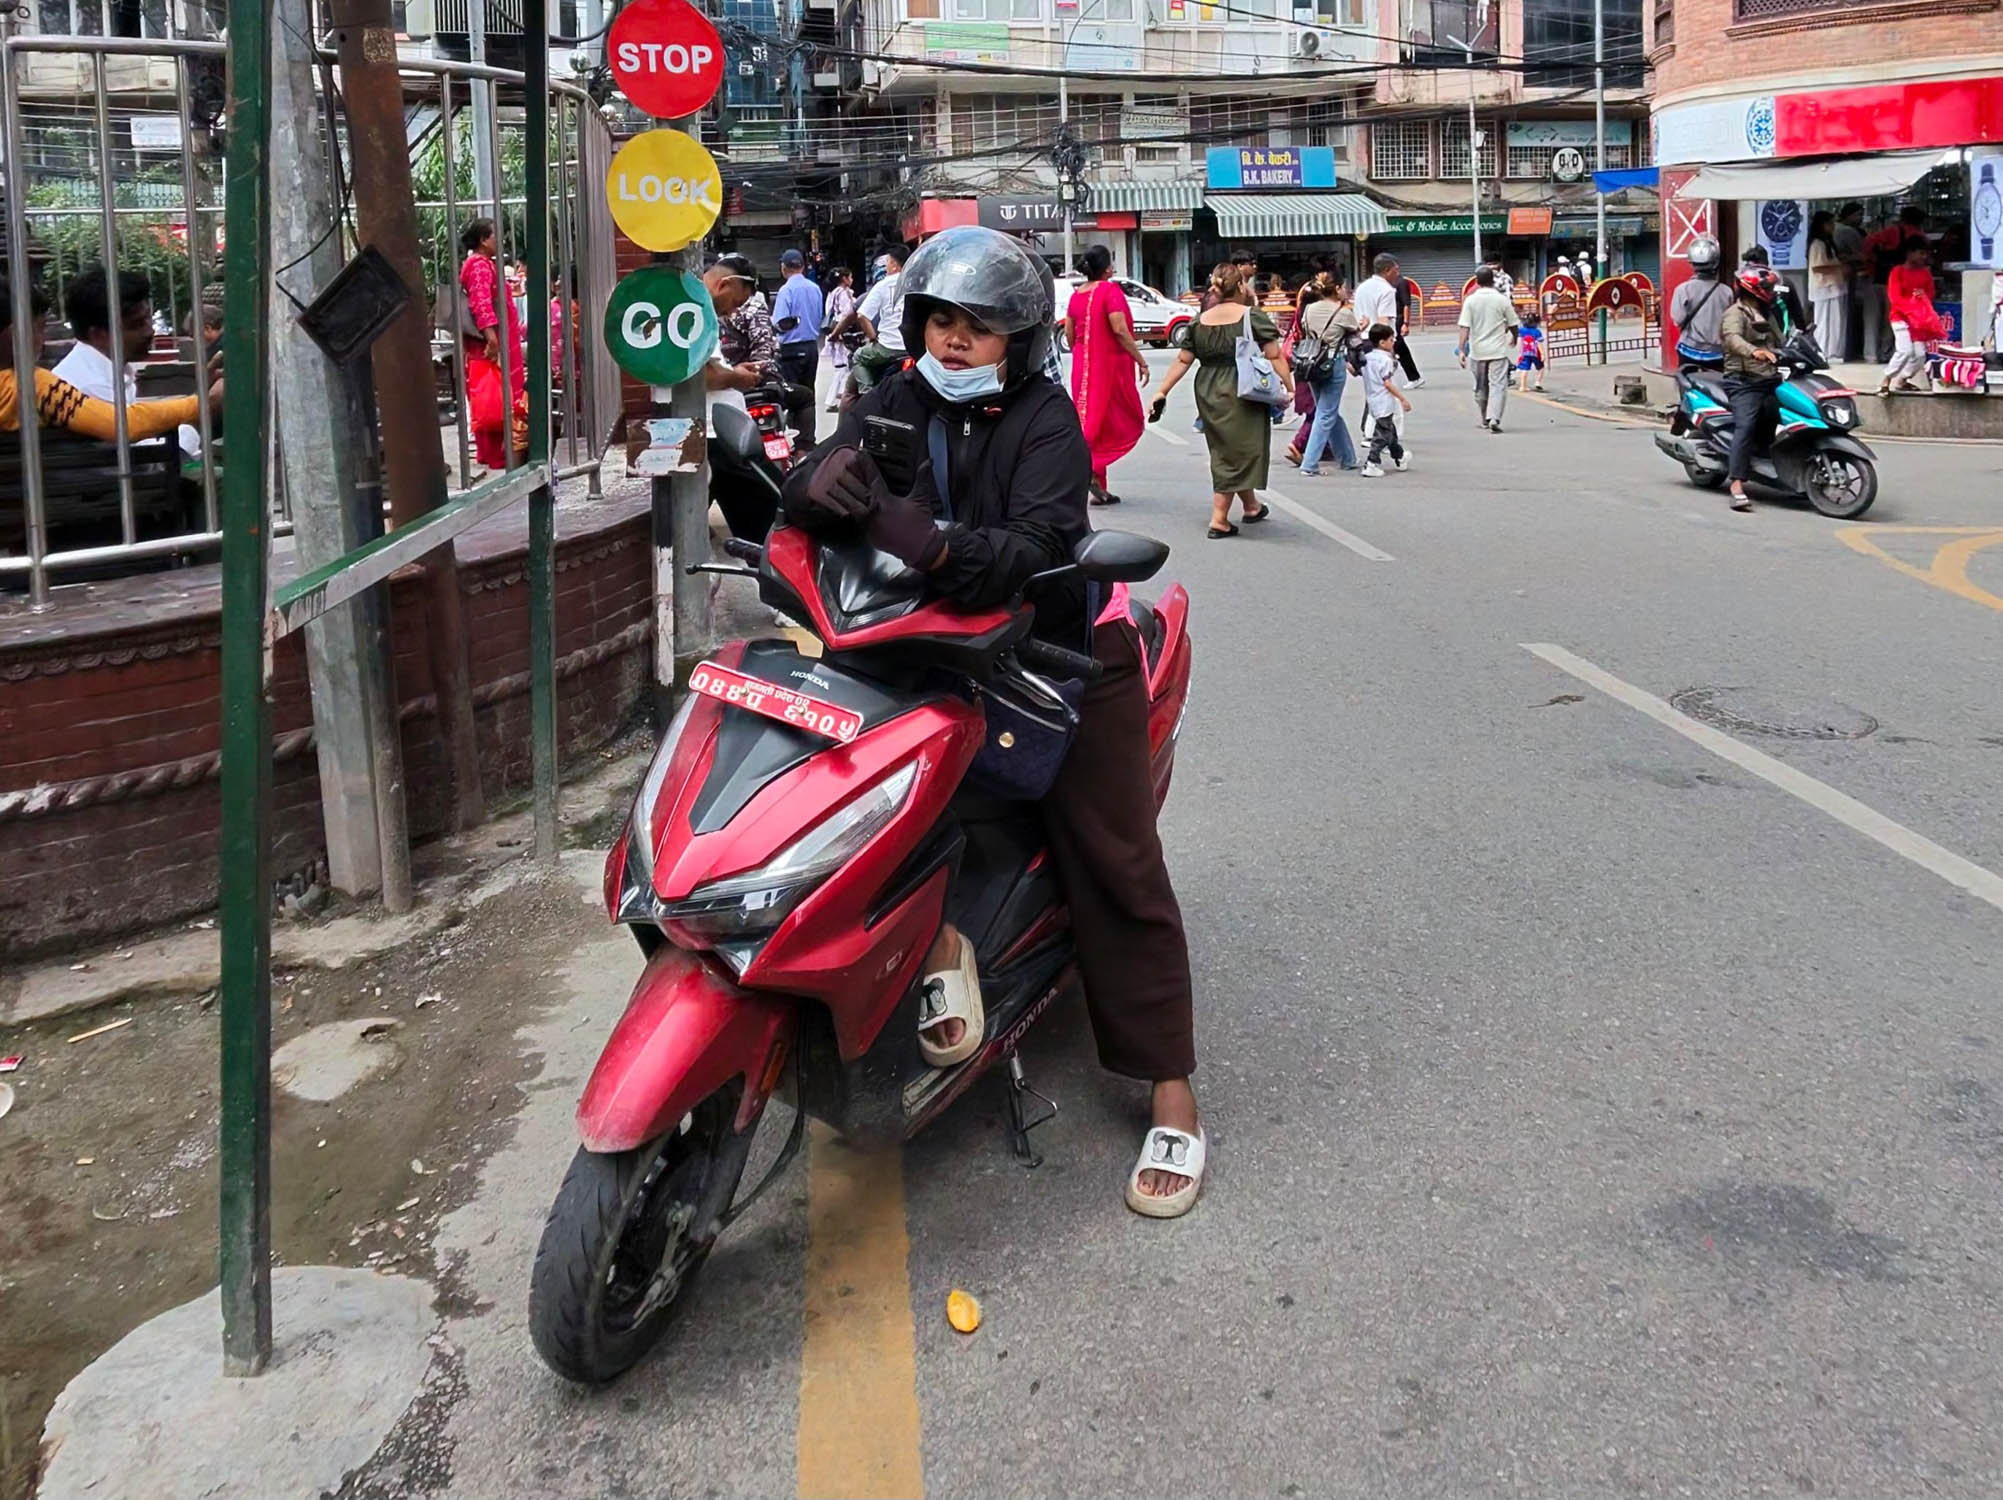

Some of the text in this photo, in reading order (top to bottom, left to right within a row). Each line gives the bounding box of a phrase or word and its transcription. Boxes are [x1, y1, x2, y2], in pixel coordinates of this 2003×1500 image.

[618, 42, 713, 74] STOP
[619, 173, 713, 206] LOOK
[1261, 169, 1293, 184] BAKERY
[1418, 220, 1448, 231] Mobile
[621, 301, 705, 349] GO
[790, 669, 830, 691] HONDA
[1002, 987, 1059, 1051] HONDA
